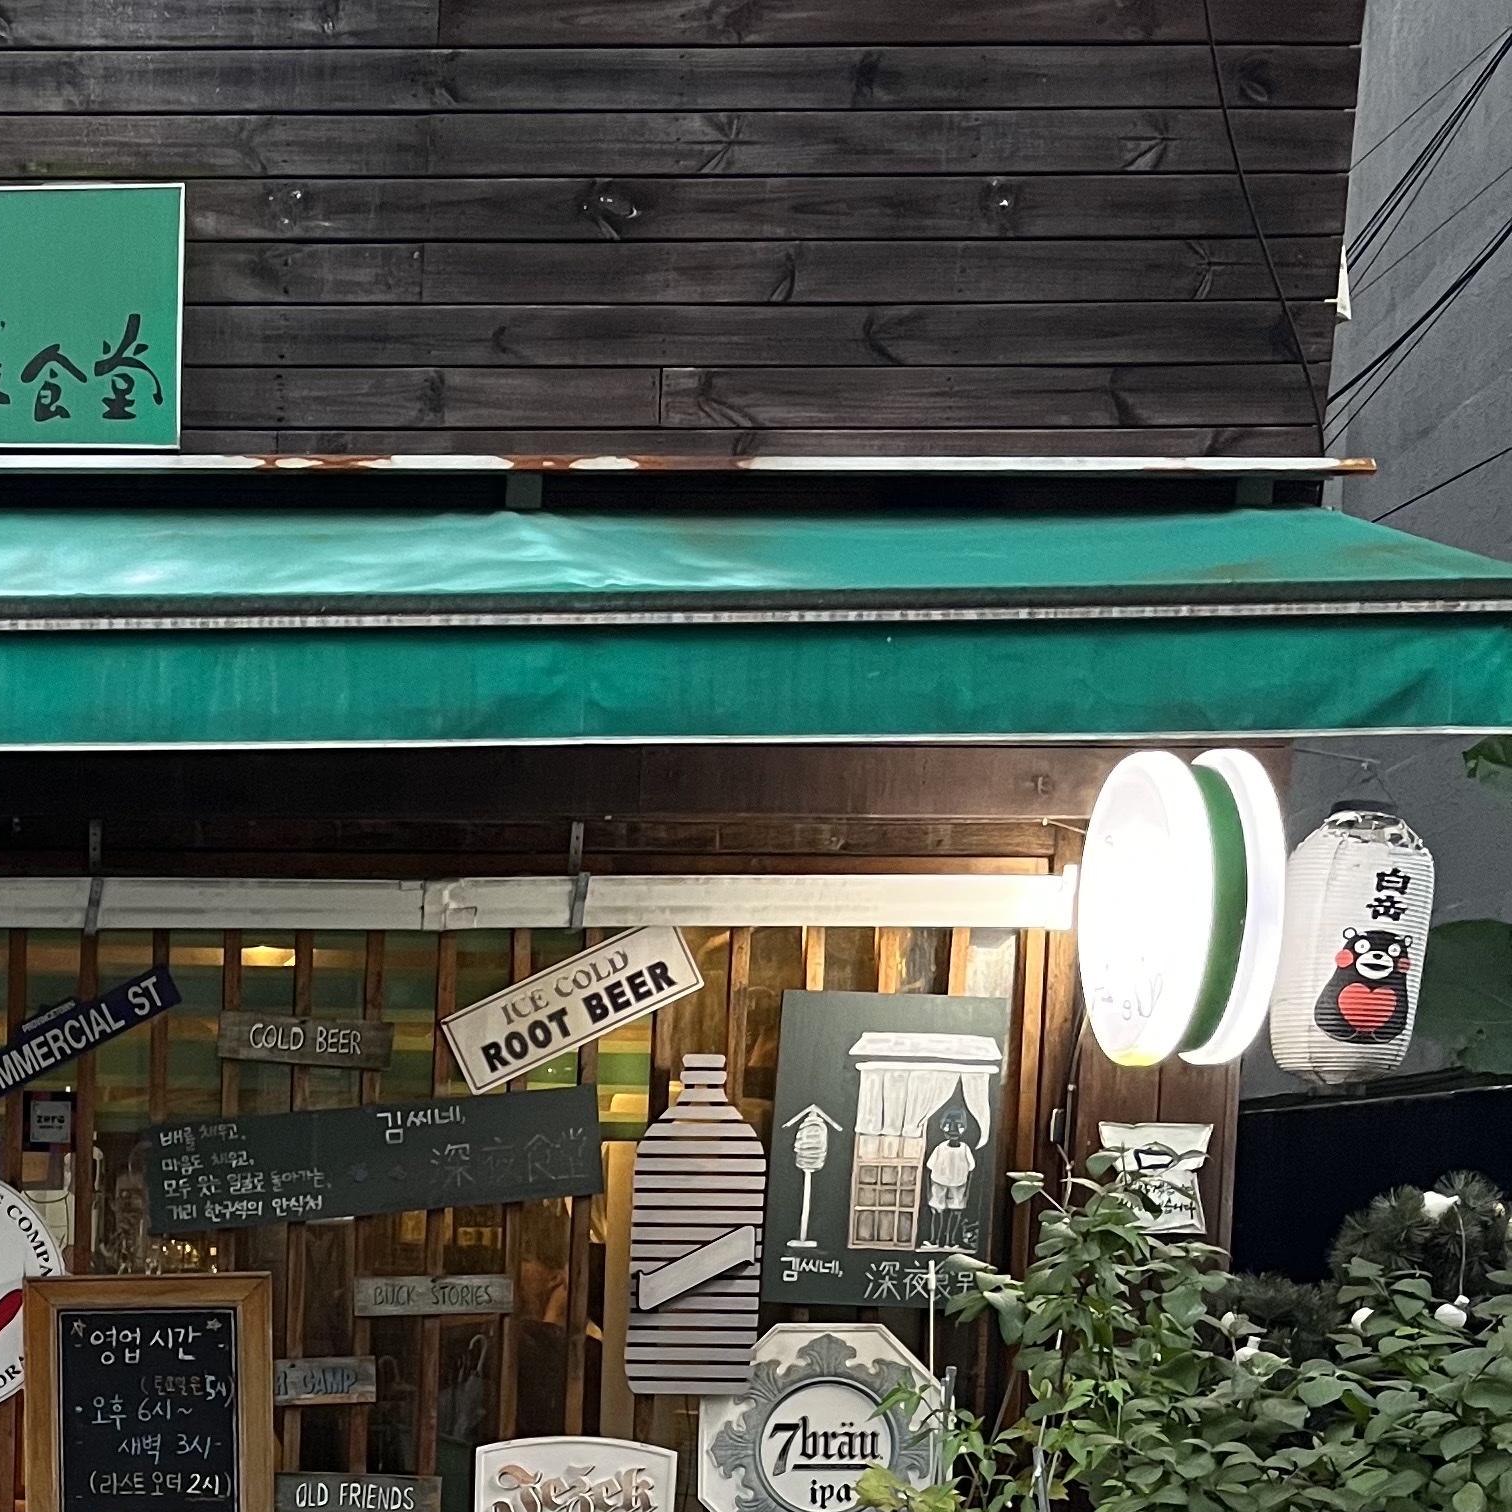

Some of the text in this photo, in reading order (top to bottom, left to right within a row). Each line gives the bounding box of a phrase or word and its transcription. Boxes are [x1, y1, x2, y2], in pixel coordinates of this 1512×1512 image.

[128, 976, 162, 1016] ST
[501, 950, 629, 1025] ICE COLD
[481, 961, 677, 1073] ROOT BEER
[250, 1023, 361, 1054] COLD BEER
[164, 1178, 191, 1199] 모두
[166, 1204, 196, 1220] 거리
[272, 1195, 322, 1216] 안식처
[7, 1205, 53, 1277] COMPA
[431, 1284, 493, 1306] STORIES
[90, 1325, 202, 1365] 영업 시간
[299, 1368, 358, 1394] CAMP
[92, 1394, 127, 1431] 오후
[117, 1433, 161, 1465] 새벽
[296, 1482, 415, 1511] OLD FRIENDS
[809, 1479, 852, 1510] ipa
